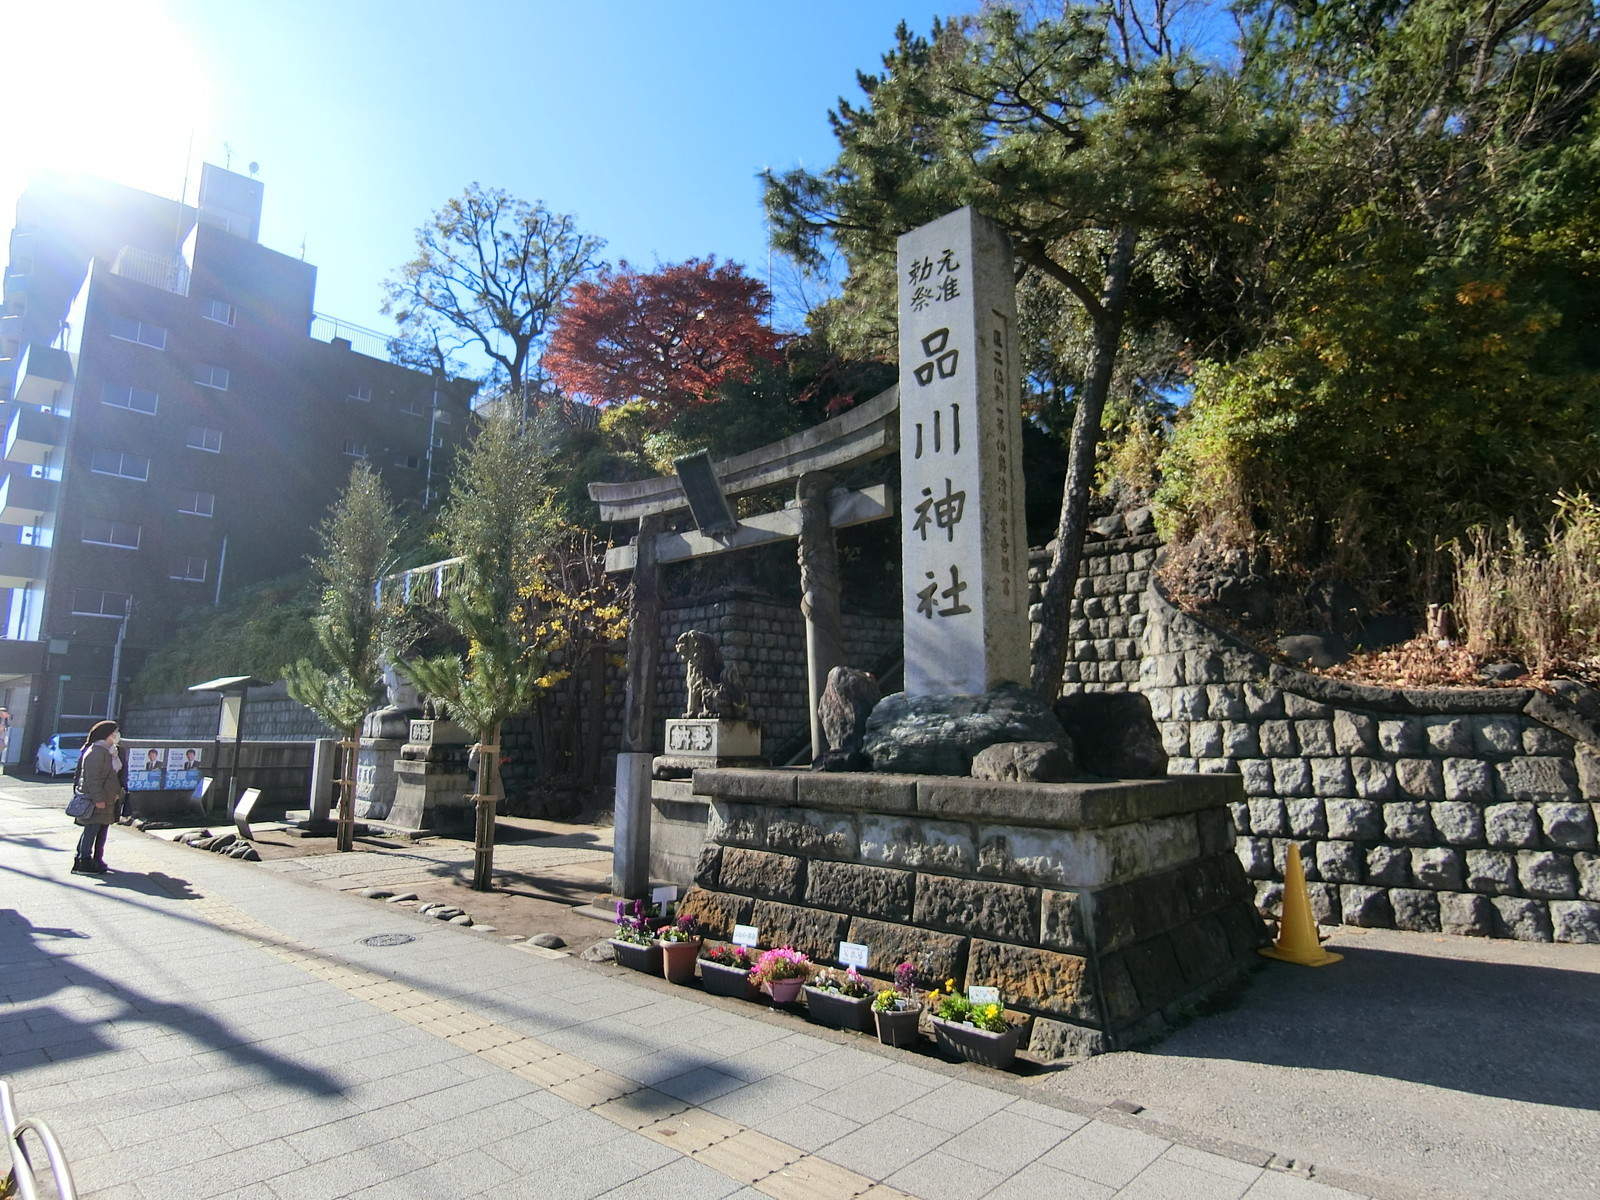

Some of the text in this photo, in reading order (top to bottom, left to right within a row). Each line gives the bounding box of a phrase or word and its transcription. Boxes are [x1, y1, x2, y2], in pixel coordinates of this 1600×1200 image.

[912, 327, 972, 619] 品川神社
[127, 780, 160, 789] ひろたか
[166, 780, 197, 788] ひろたか
